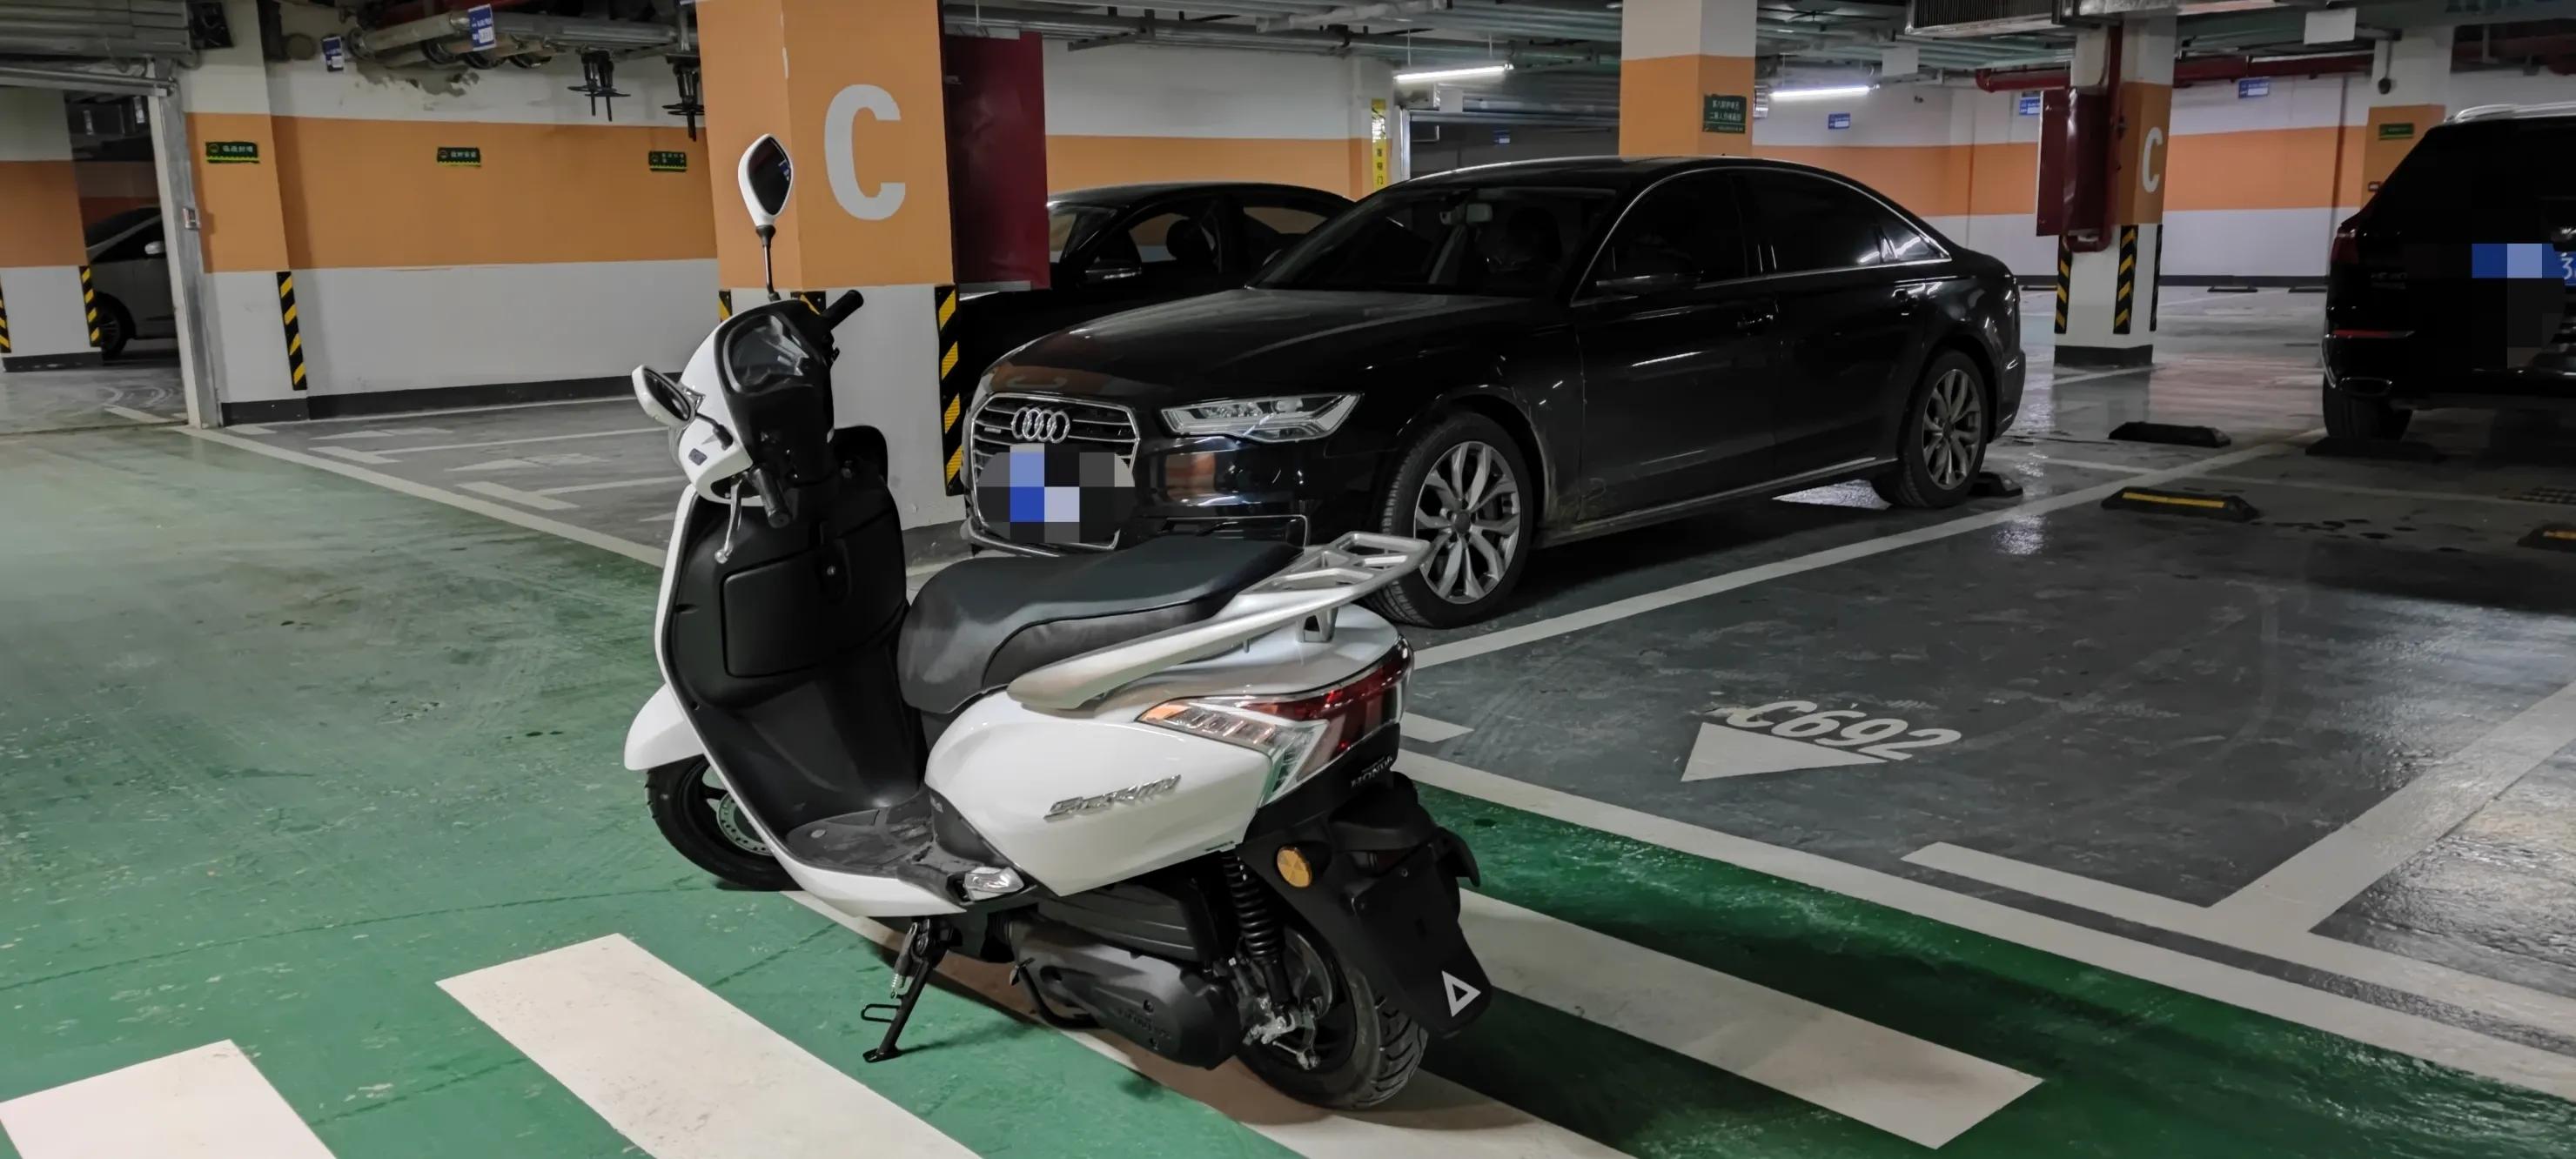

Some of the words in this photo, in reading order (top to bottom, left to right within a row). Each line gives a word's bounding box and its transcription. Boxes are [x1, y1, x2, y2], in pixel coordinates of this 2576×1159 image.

[824, 84, 906, 221] C
[2143, 126, 2163, 192] C
[1727, 700, 1962, 760] C692
